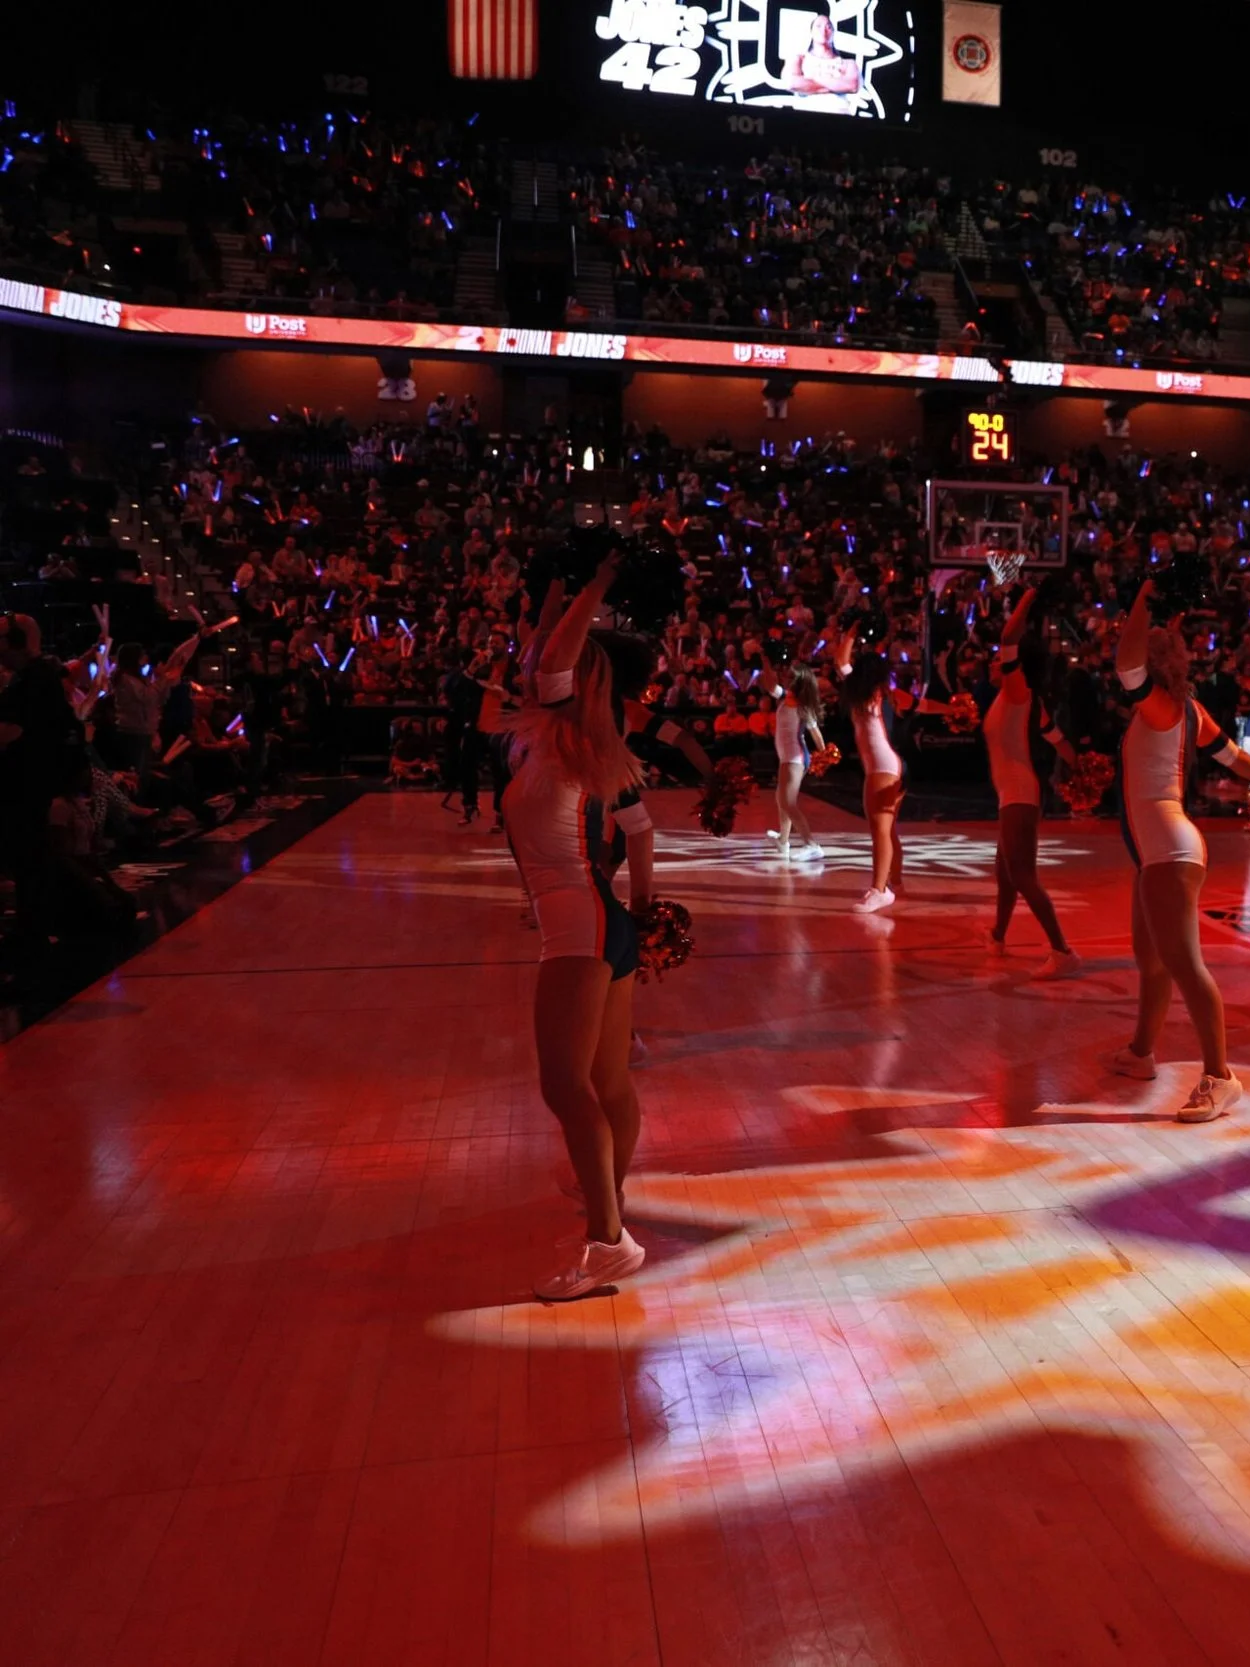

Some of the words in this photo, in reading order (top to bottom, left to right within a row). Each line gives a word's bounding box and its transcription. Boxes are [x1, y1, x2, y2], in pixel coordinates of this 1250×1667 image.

[595, 0, 708, 49] JONES
[599, 42, 701, 96] 42
[727, 114, 765, 136] 101
[1038, 147, 1078, 169] 102
[49, 291, 122, 327] JONES
[269, 315, 306, 332] Post
[556, 331, 627, 360] JONES
[753, 343, 786, 360] Post
[376, 376, 418, 402] 28
[1173, 372, 1203, 388] Post
[972, 431, 1009, 460] 24
